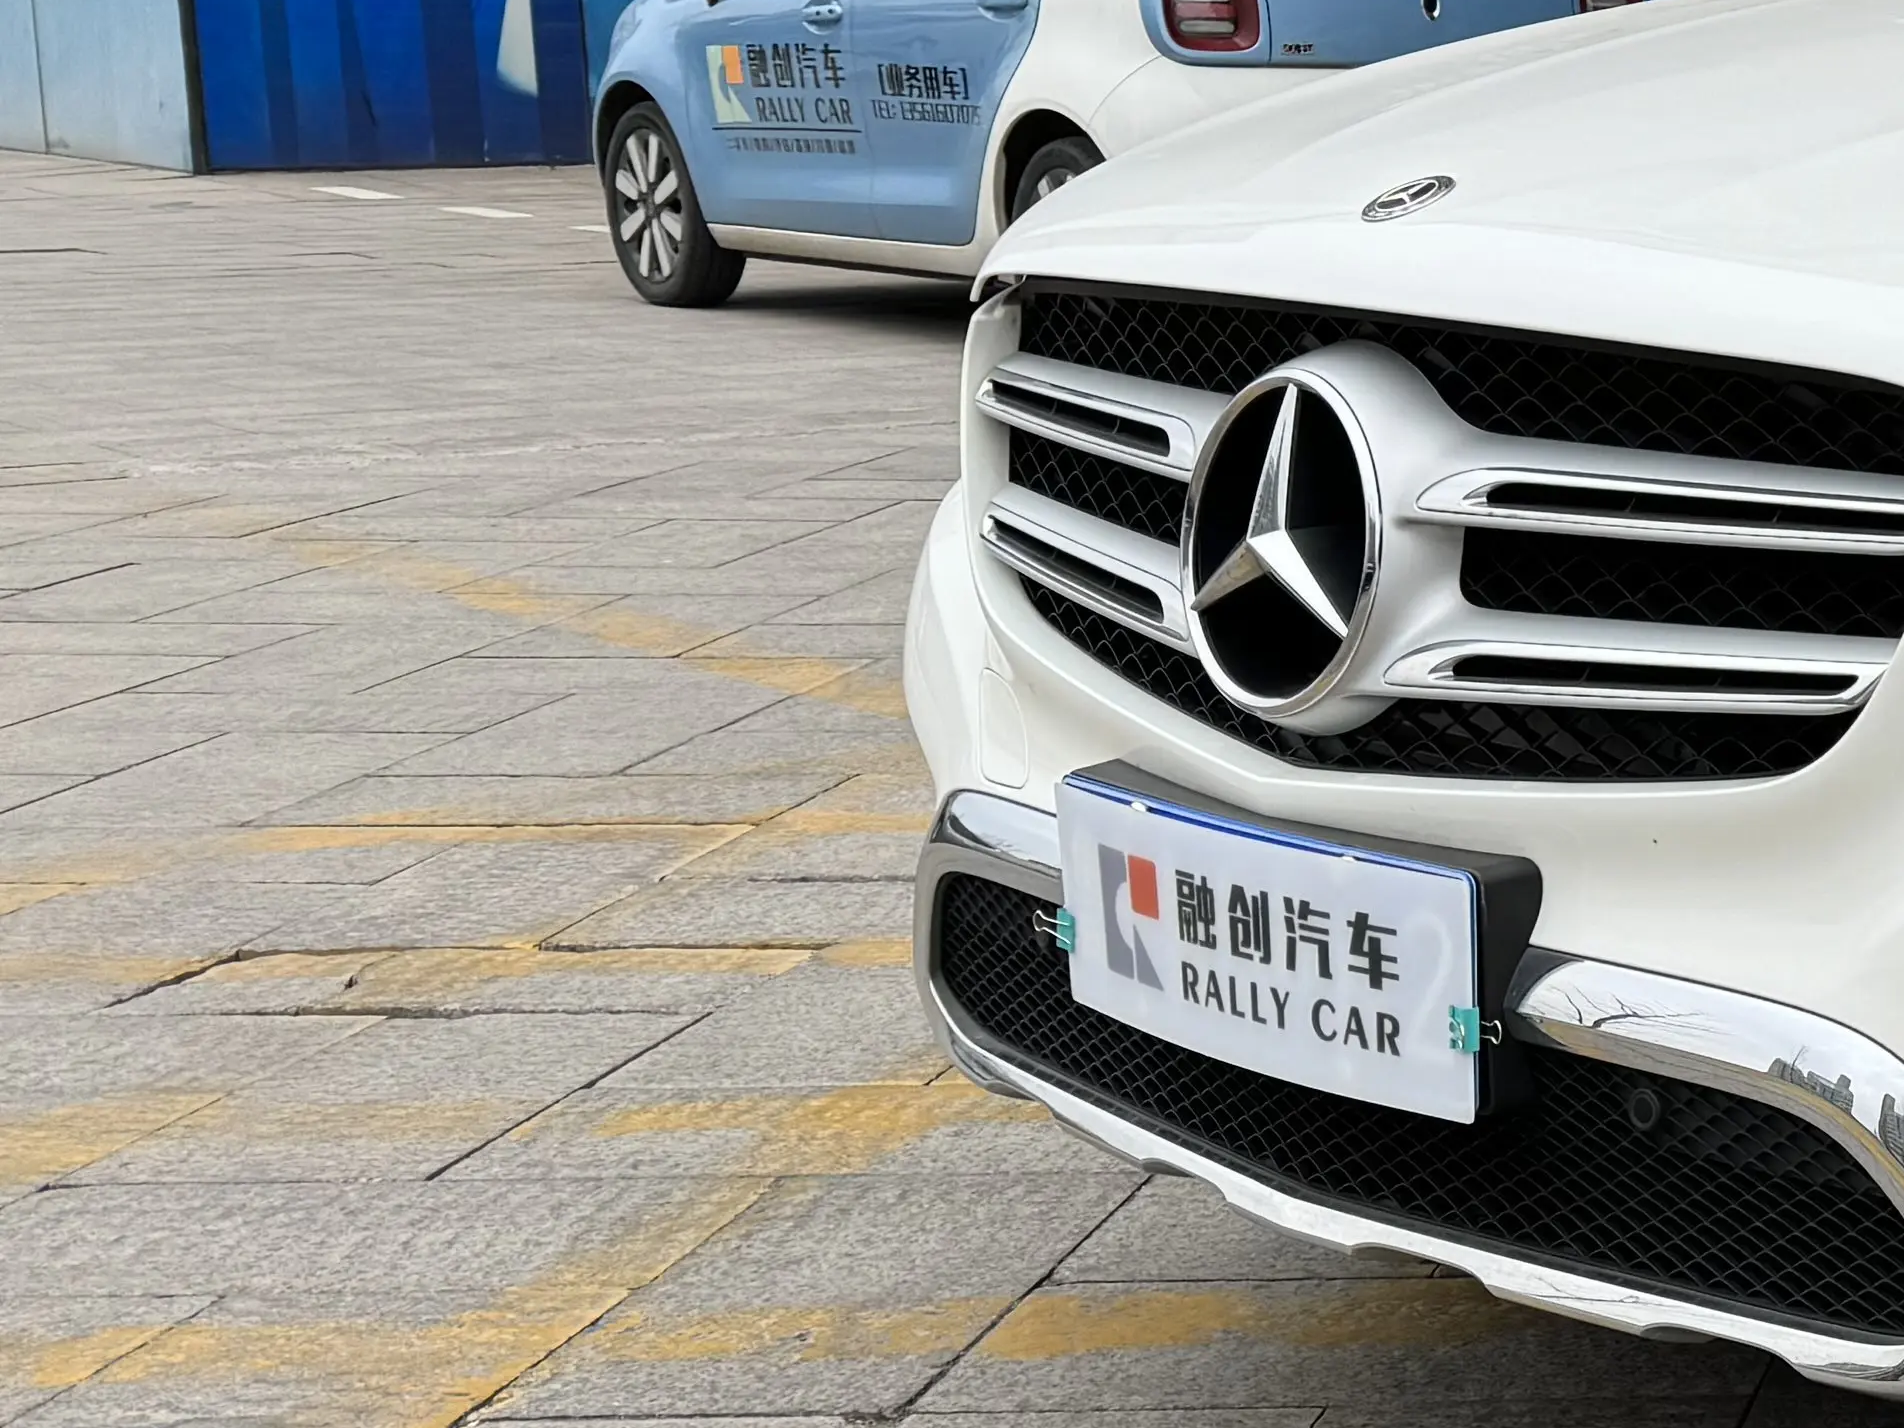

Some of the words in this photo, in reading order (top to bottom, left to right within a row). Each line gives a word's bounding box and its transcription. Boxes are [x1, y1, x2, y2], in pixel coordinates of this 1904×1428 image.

[745, 42, 846, 90] 融创汽车
[755, 96, 806, 124] RALLY
[815, 97, 855, 126] CAR
[1175, 868, 1401, 991] 融创汽车
[1181, 960, 1290, 1031] RALLY
[1311, 997, 1402, 1057] CAR
